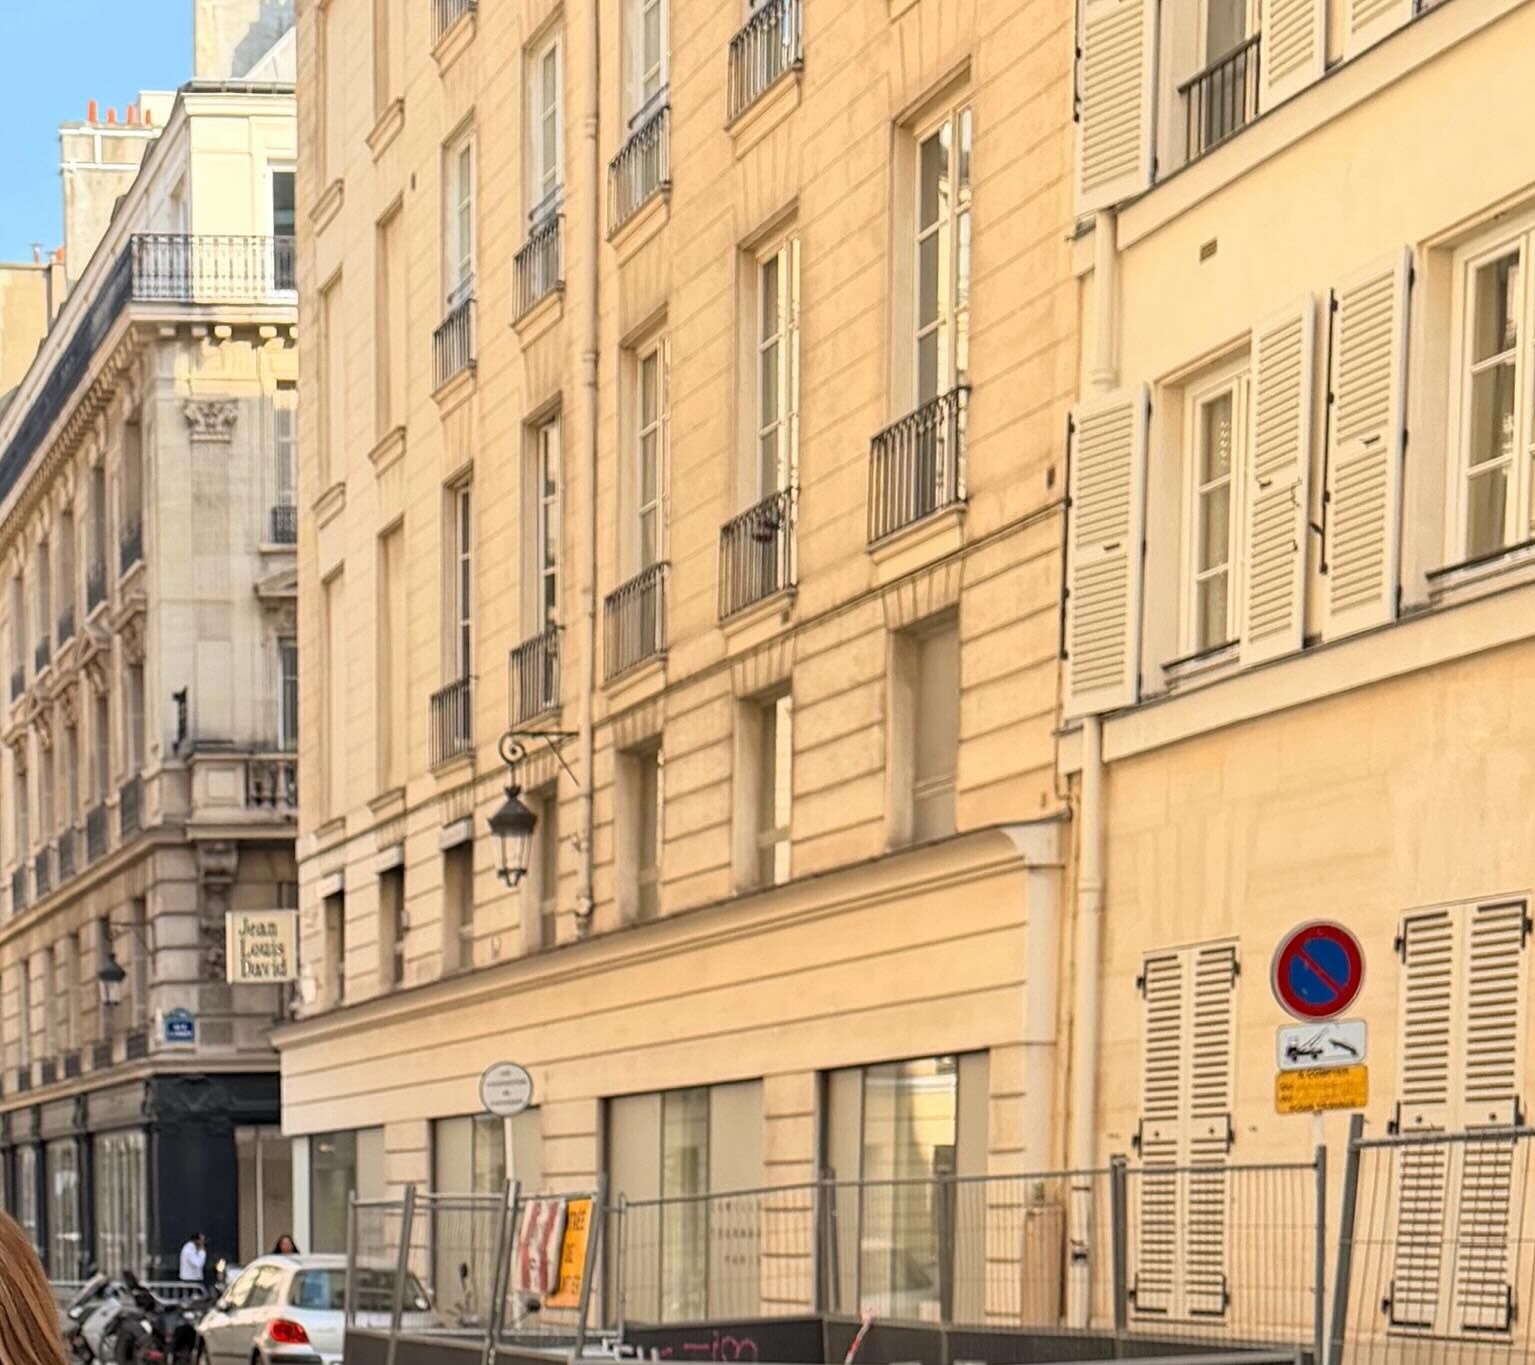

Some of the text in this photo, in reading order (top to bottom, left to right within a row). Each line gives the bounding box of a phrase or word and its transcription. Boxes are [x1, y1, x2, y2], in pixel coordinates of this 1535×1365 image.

[238, 917, 278, 937] Jean
[240, 938, 285, 958] Louis
[240, 957, 287, 978] David
